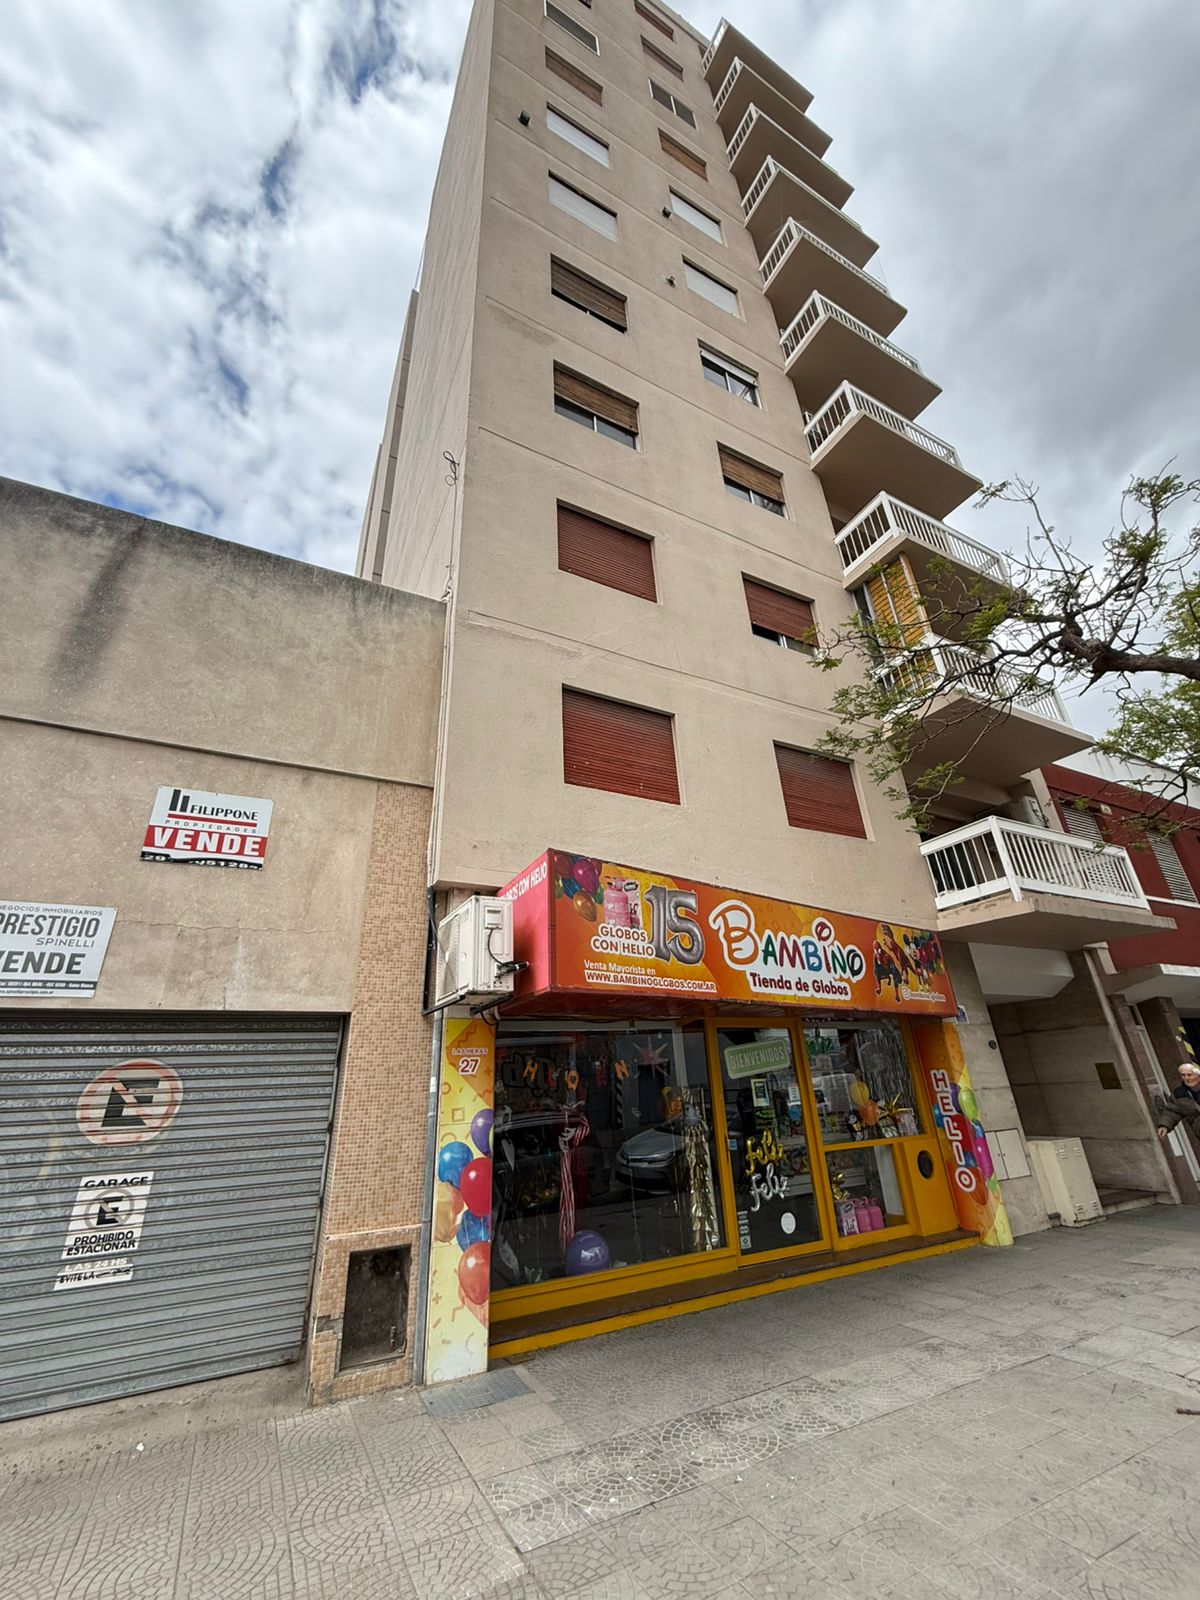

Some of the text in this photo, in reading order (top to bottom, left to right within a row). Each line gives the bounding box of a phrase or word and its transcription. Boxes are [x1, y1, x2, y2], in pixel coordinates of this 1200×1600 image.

[190, 803, 260, 822] FILIPPONE
[165, 819, 257, 834] PROPIEDADES
[153, 827, 262, 856] VENDE
[518, 873, 531, 897] CON
[530, 861, 548, 889] HELIO
[40, 907, 104, 916] INMOBILIARIOS
[599, 924, 648, 943] GLOBOS
[710, 901, 865, 980] BAMBINO
[35, 937, 96, 948] SPINELLI
[592, 937, 655, 957] CON HELIO
[583, 959, 656, 975] Venta Mayorista en
[586, 971, 716, 991] WWW.BAMBINOGLOBOS.COM.AR
[749, 972, 849, 997] Tienda de Globos
[452, 1047, 488, 1056] LAS HERAS
[729, 1045, 786, 1071] BIENVENIDOS
[460, 1058, 480, 1074] 27
[930, 1069, 977, 1194] HELIO
[84, 1176, 149, 1188] GARAGE
[73, 1230, 134, 1246] PROHIBIDO
[66, 1240, 137, 1256] ESTACIONAR
[65, 1257, 128, 1272] LAS 24 HS
